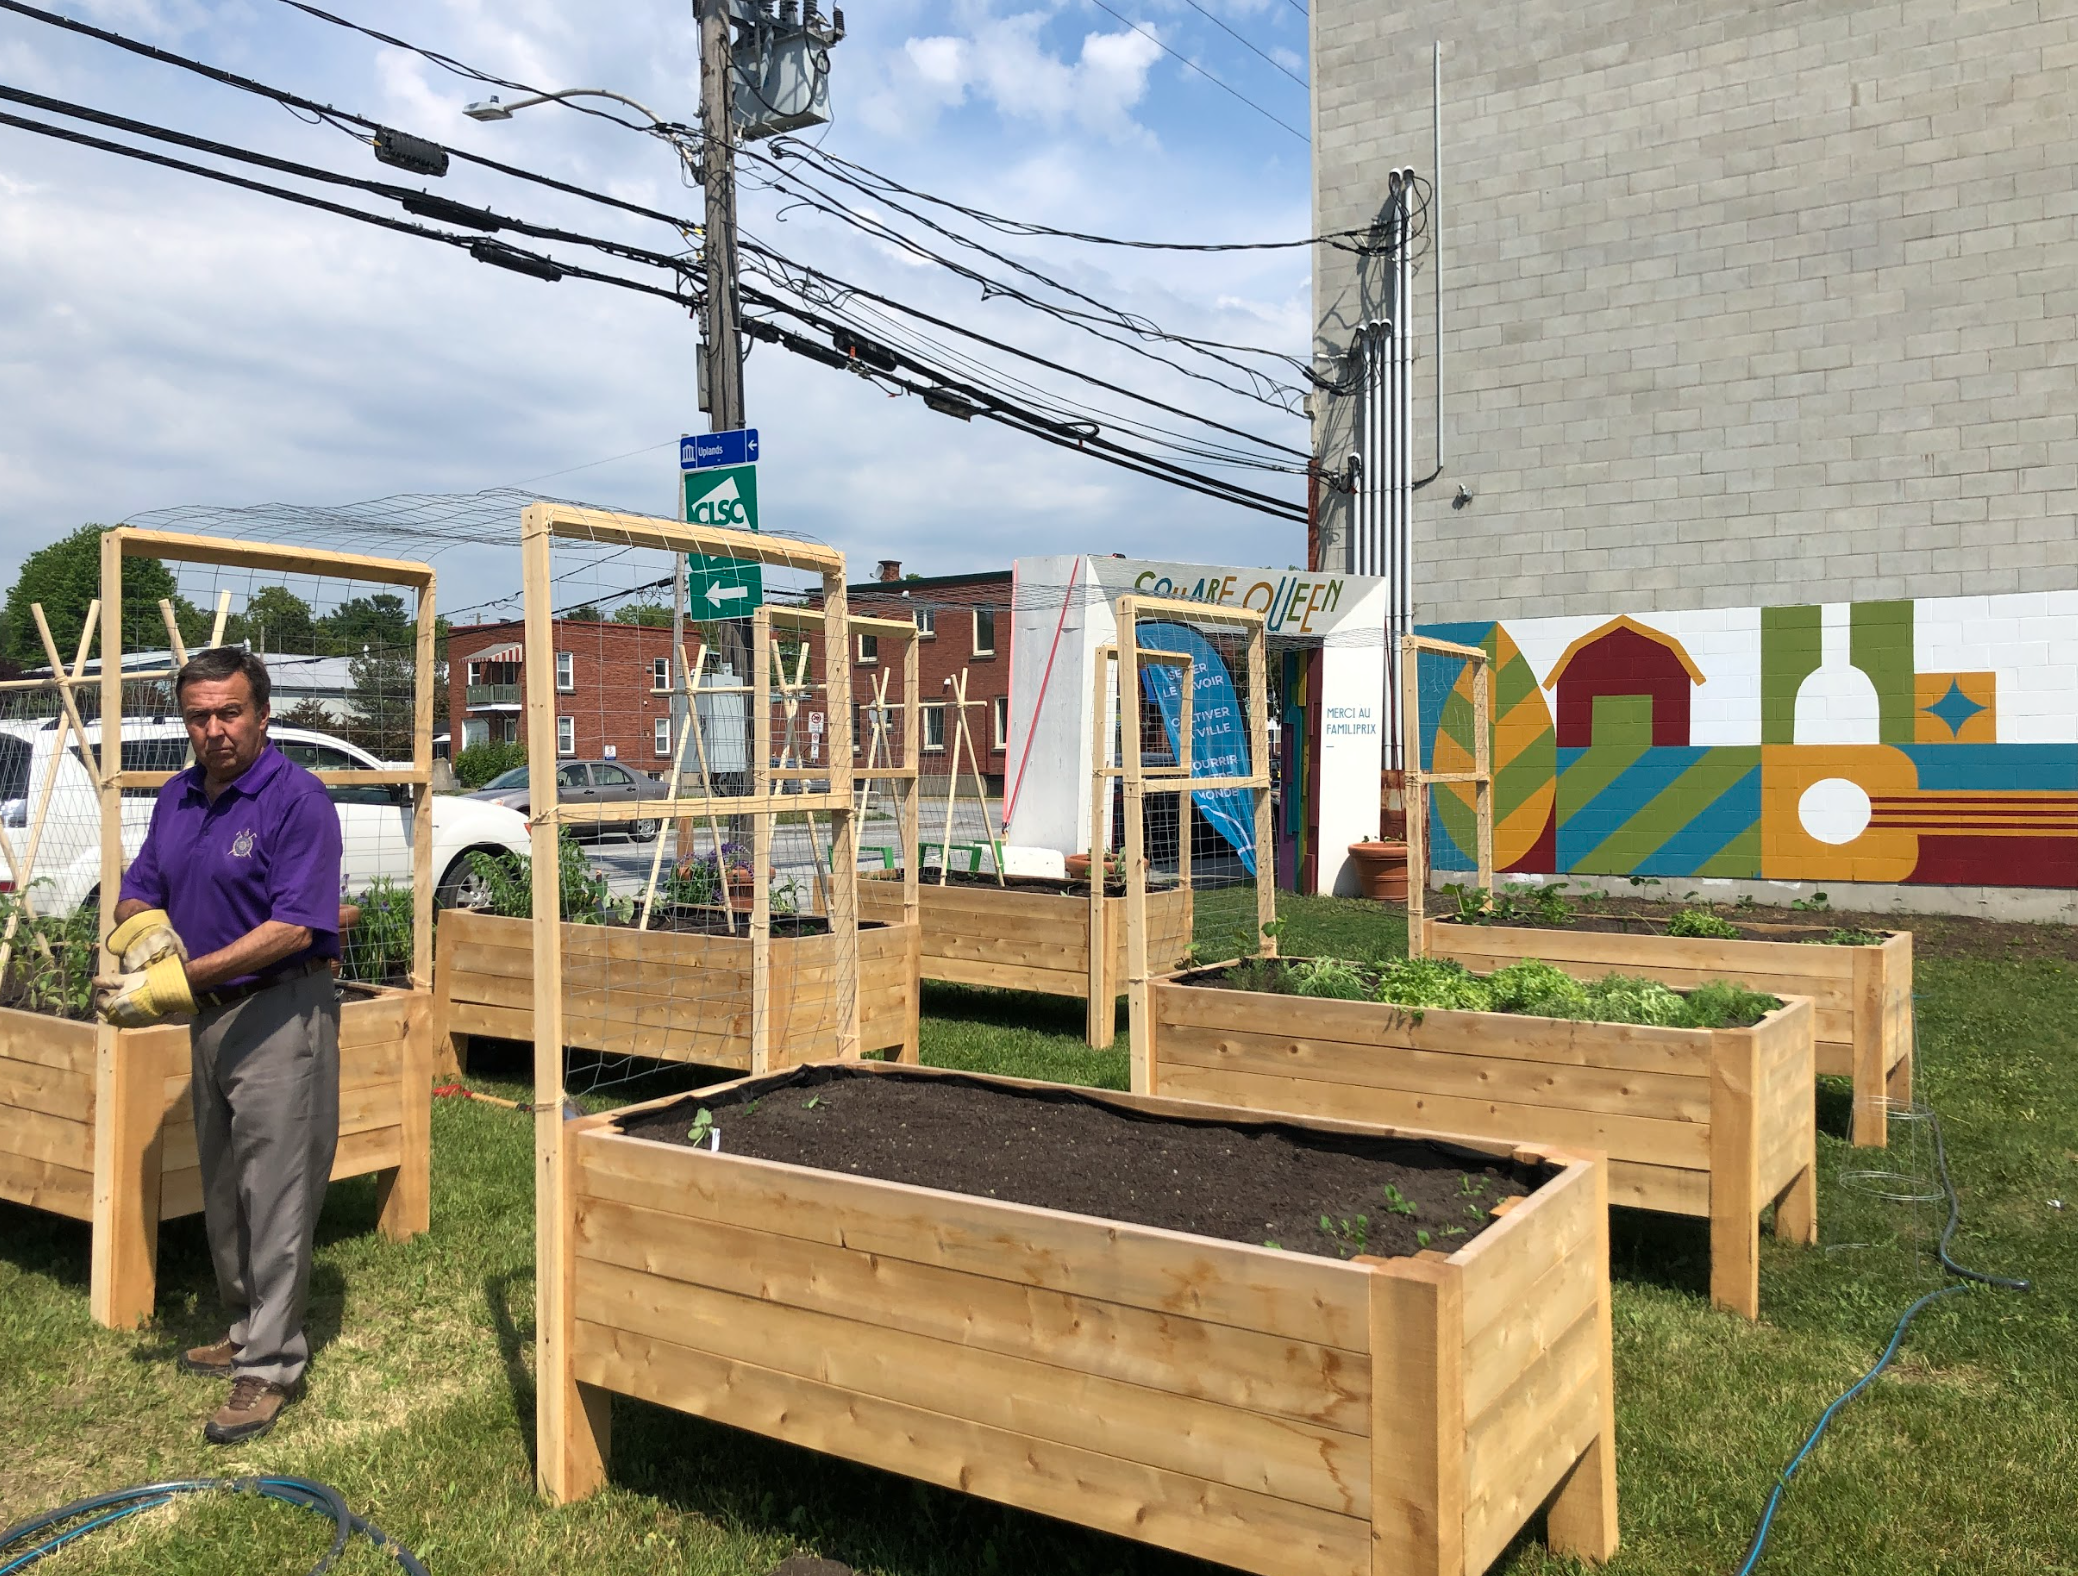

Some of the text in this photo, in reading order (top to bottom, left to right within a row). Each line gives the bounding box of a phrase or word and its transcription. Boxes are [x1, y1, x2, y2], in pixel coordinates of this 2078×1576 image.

[698, 445, 723, 458] Uplands
[694, 497, 746, 525] CLSC
[1243, 576, 1344, 632] QUEEN
[1168, 663, 1208, 680] SEER
[1163, 675, 1224, 697] LE VOIR
[1171, 707, 1230, 727] CTIVER
[1327, 708, 1371, 718] MERCI AU
[1197, 722, 1231, 737] VILLE
[1326, 724, 1376, 734] FAMILIPRIX
[1194, 754, 1238, 770] OURRIR
